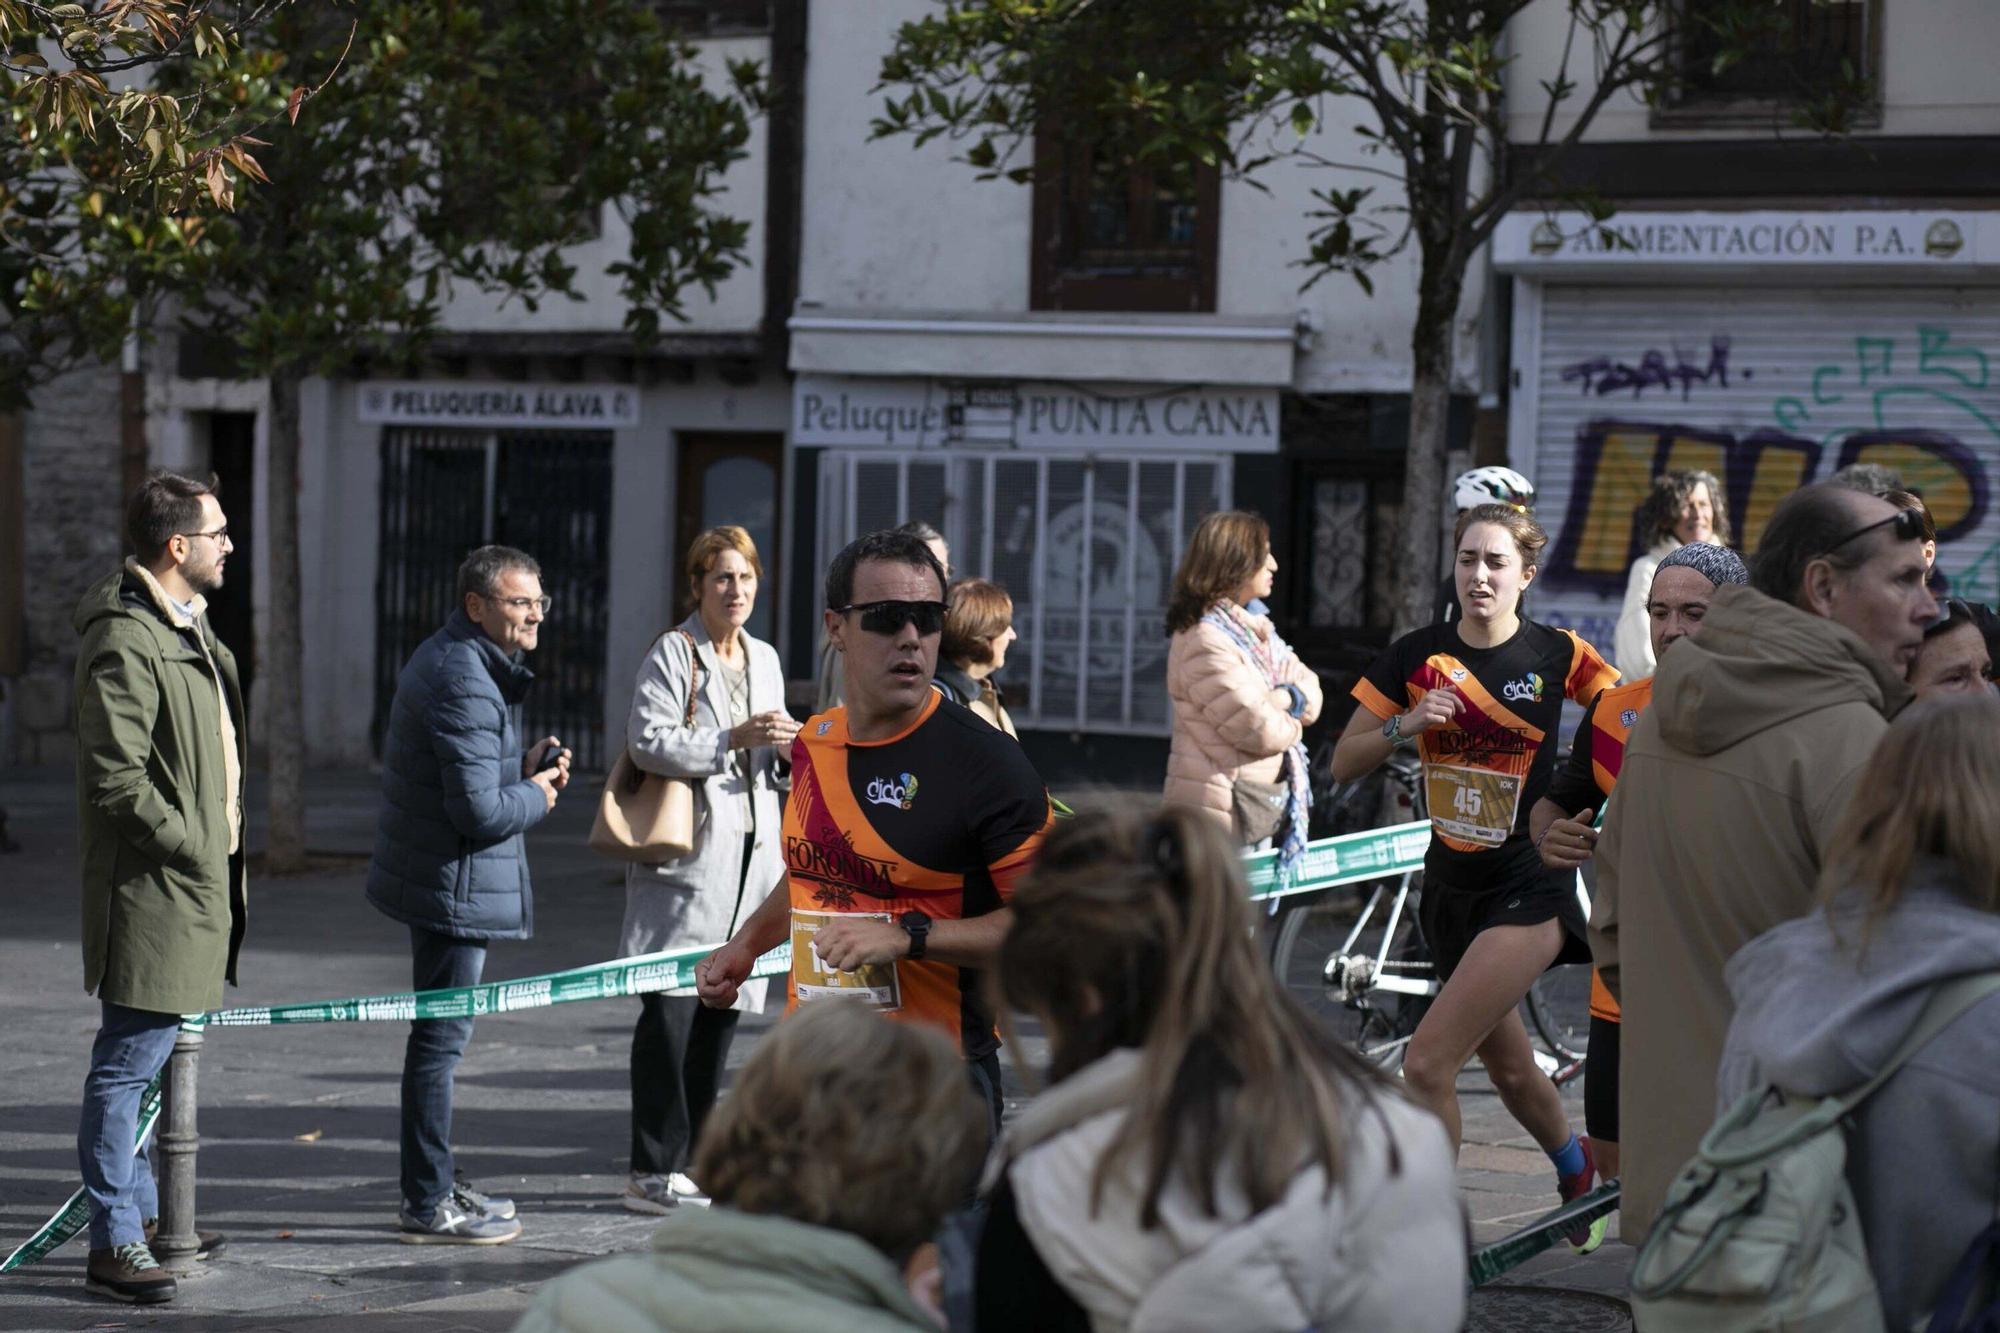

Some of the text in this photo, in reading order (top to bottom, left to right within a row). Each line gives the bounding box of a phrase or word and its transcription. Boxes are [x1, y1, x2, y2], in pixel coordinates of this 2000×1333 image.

[1855, 226, 1915, 255] P.A.
[391, 390, 526, 415] PELUQUERÍA
[1029, 396, 1273, 436] PUNTA CANA
[1453, 786, 1482, 817] 45
[786, 835, 897, 894] FORONDA
